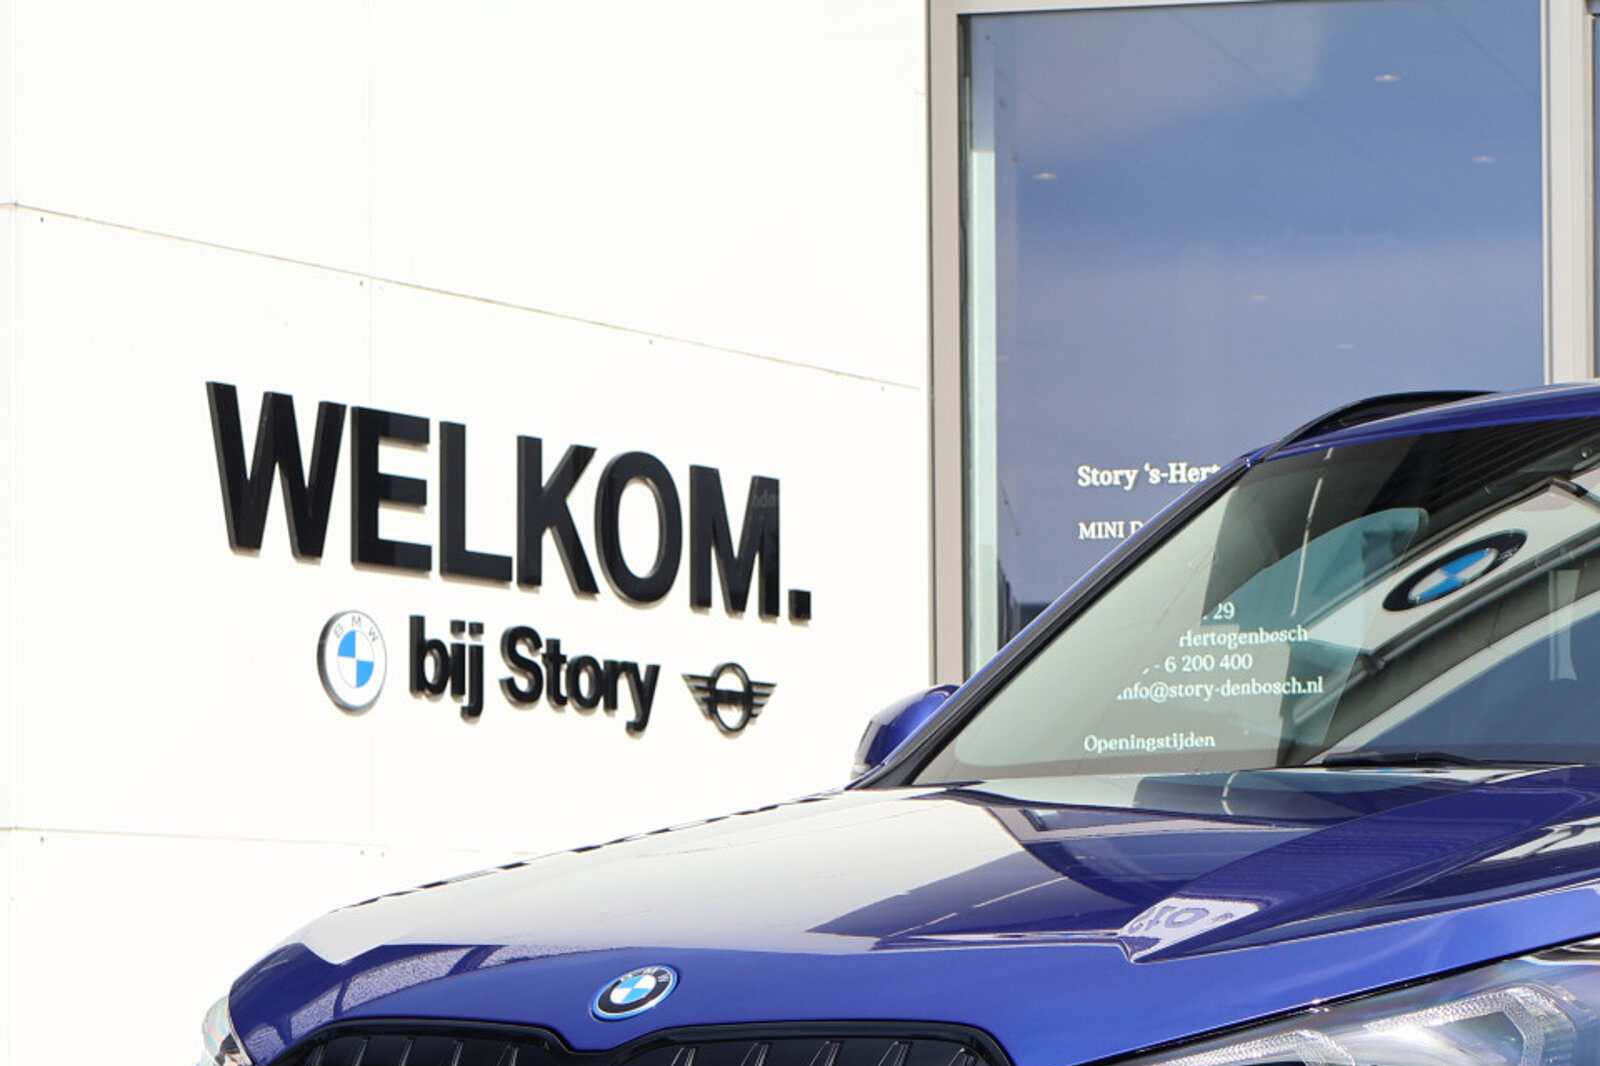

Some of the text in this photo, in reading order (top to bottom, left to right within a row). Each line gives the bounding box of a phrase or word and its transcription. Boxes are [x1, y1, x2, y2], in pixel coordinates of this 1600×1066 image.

[1077, 465, 1138, 490] Story
[206, 381, 811, 621] WELKOM.
[1078, 521, 1124, 539] MINI
[409, 615, 660, 733] bij Story
[1164, 656, 1176, 673] 6
[1181, 654, 1215, 672] 200
[1219, 653, 1253, 671] 400
[1083, 732, 1217, 754] Openingstijden
